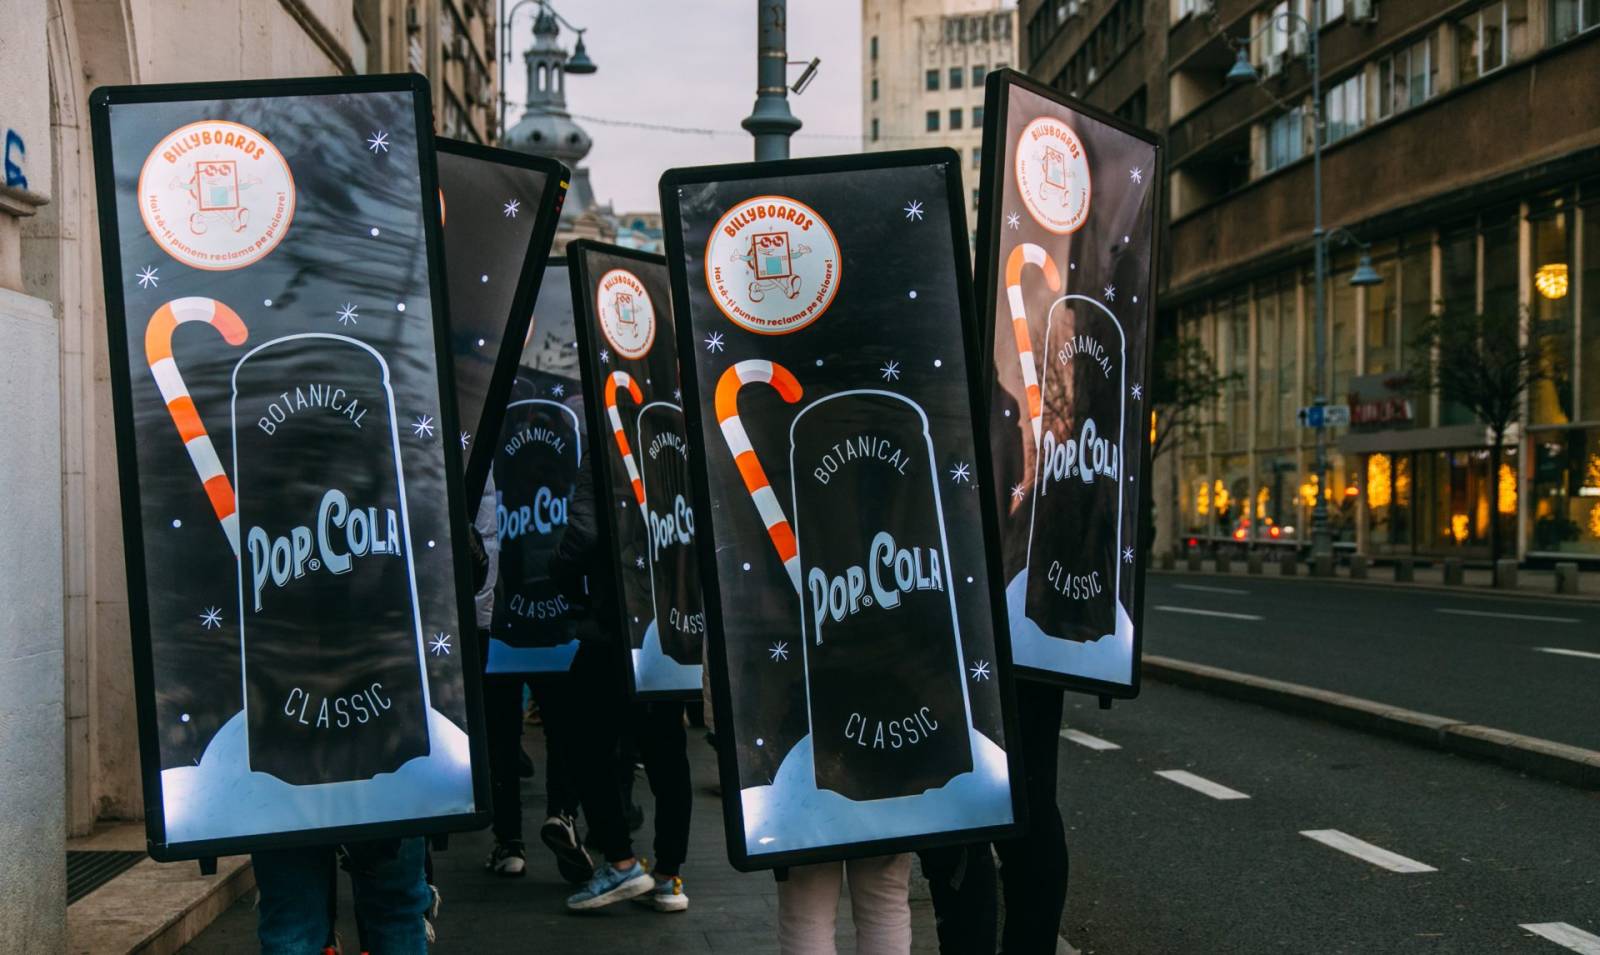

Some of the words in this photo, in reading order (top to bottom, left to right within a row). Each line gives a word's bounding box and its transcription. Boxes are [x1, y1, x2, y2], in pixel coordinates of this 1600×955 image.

[163, 130, 265, 164] BILLYBOARDS
[1031, 124, 1080, 160] BILLYBOARDS
[724, 205, 813, 237] BILLYBOARDS
[170, 238, 208, 259] punem
[255, 236, 267, 249] pe
[714, 266, 724, 283] Hai
[733, 306, 765, 325] punem
[767, 310, 807, 325] reclama
[806, 302, 817, 315] pe
[816, 259, 833, 303] picioare!
[1058, 335, 1113, 379] BOTANICAL
[257, 383, 368, 436] BOTANICAL
[504, 427, 567, 456] BOTANICAL
[814, 435, 911, 485] BOTANICAL
[1079, 418, 1118, 484] COLA
[317, 489, 402, 575] COLA
[534, 486, 570, 536] COL
[675, 494, 695, 545] CO
[869, 531, 944, 609] COLA
[1047, 560, 1102, 600] CLASSIC
[510, 594, 569, 619] CLASSIC
[669, 607, 705, 634] CLASS
[284, 682, 391, 728] CLASSIC
[844, 706, 939, 750] CLASSIC
